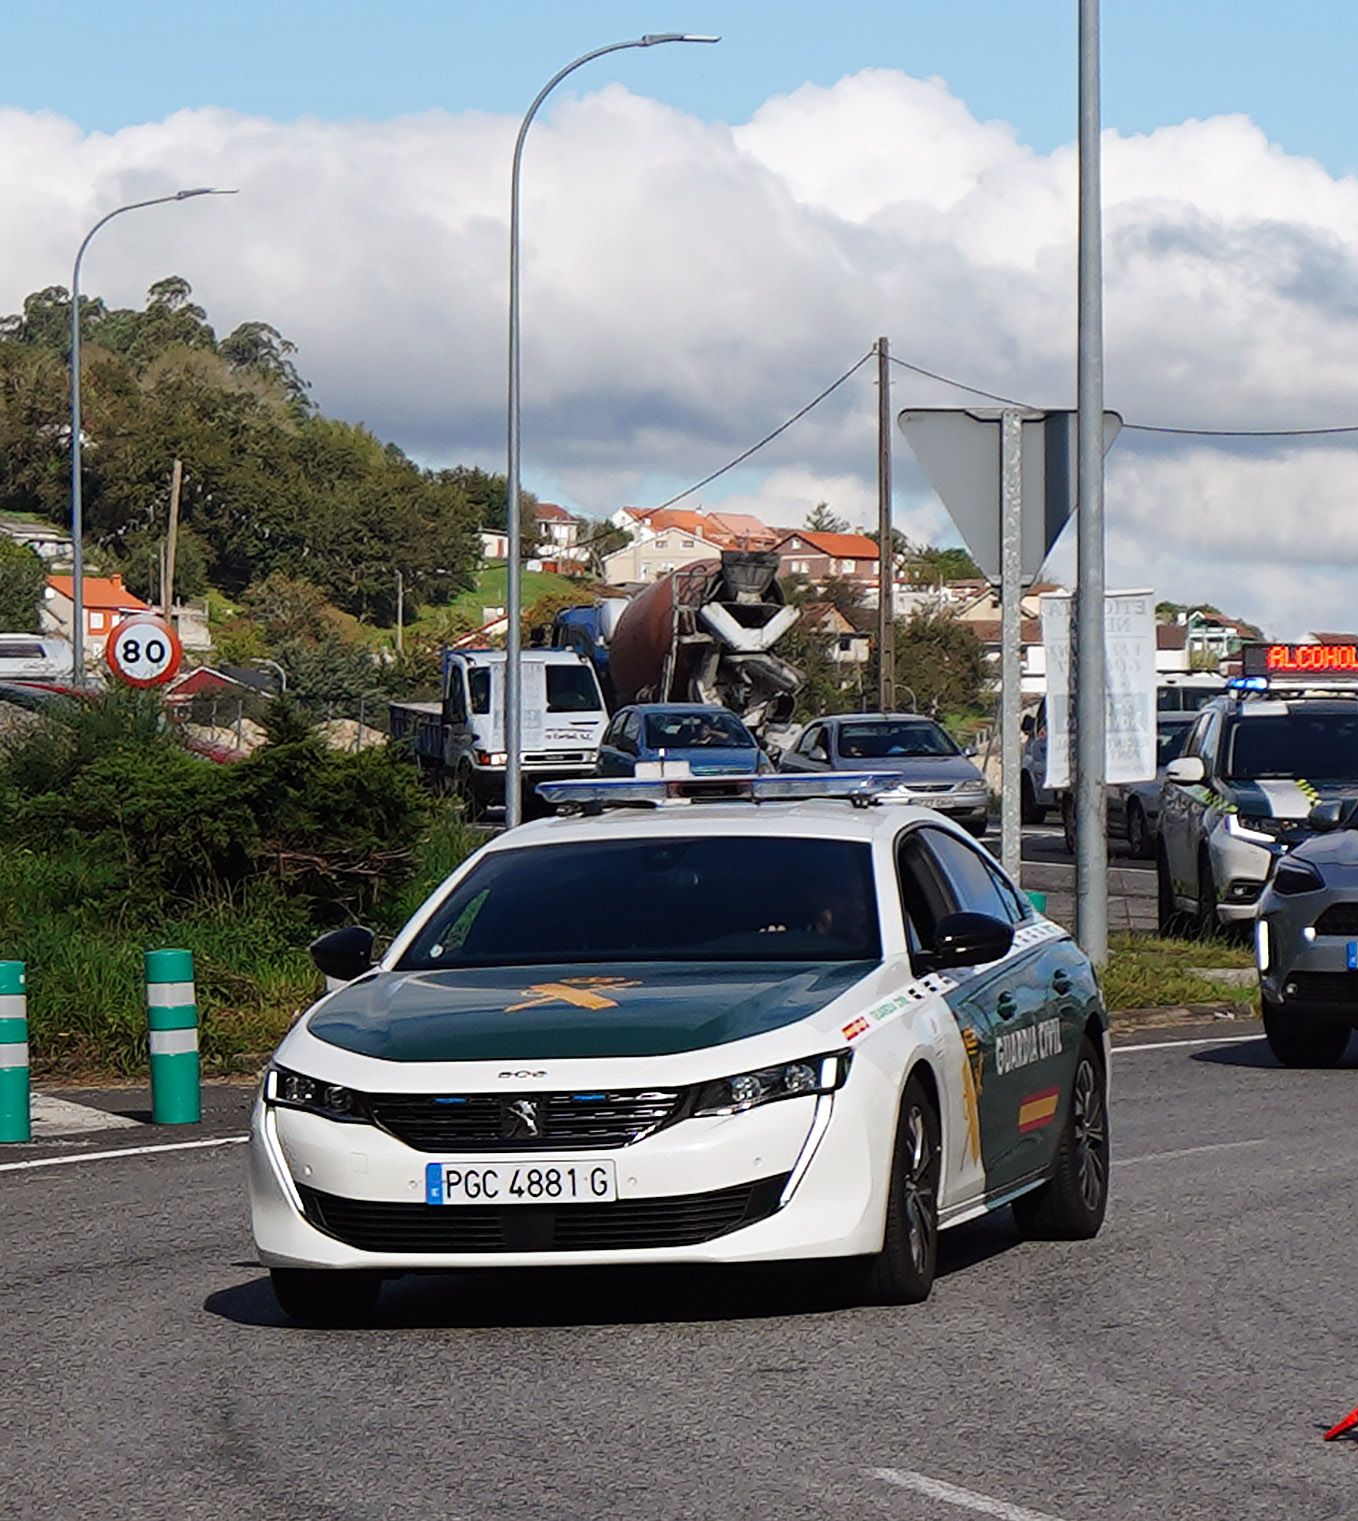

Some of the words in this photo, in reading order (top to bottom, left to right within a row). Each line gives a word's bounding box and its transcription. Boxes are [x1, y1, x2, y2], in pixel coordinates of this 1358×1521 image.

[122, 639, 165, 664] 80
[995, 1024, 1039, 1076] GUARDIA
[1038, 1017, 1063, 1060] CIVIL
[446, 1169, 499, 1199] PGC
[509, 1167, 577, 1198] 4881
[590, 1167, 608, 1196] G
